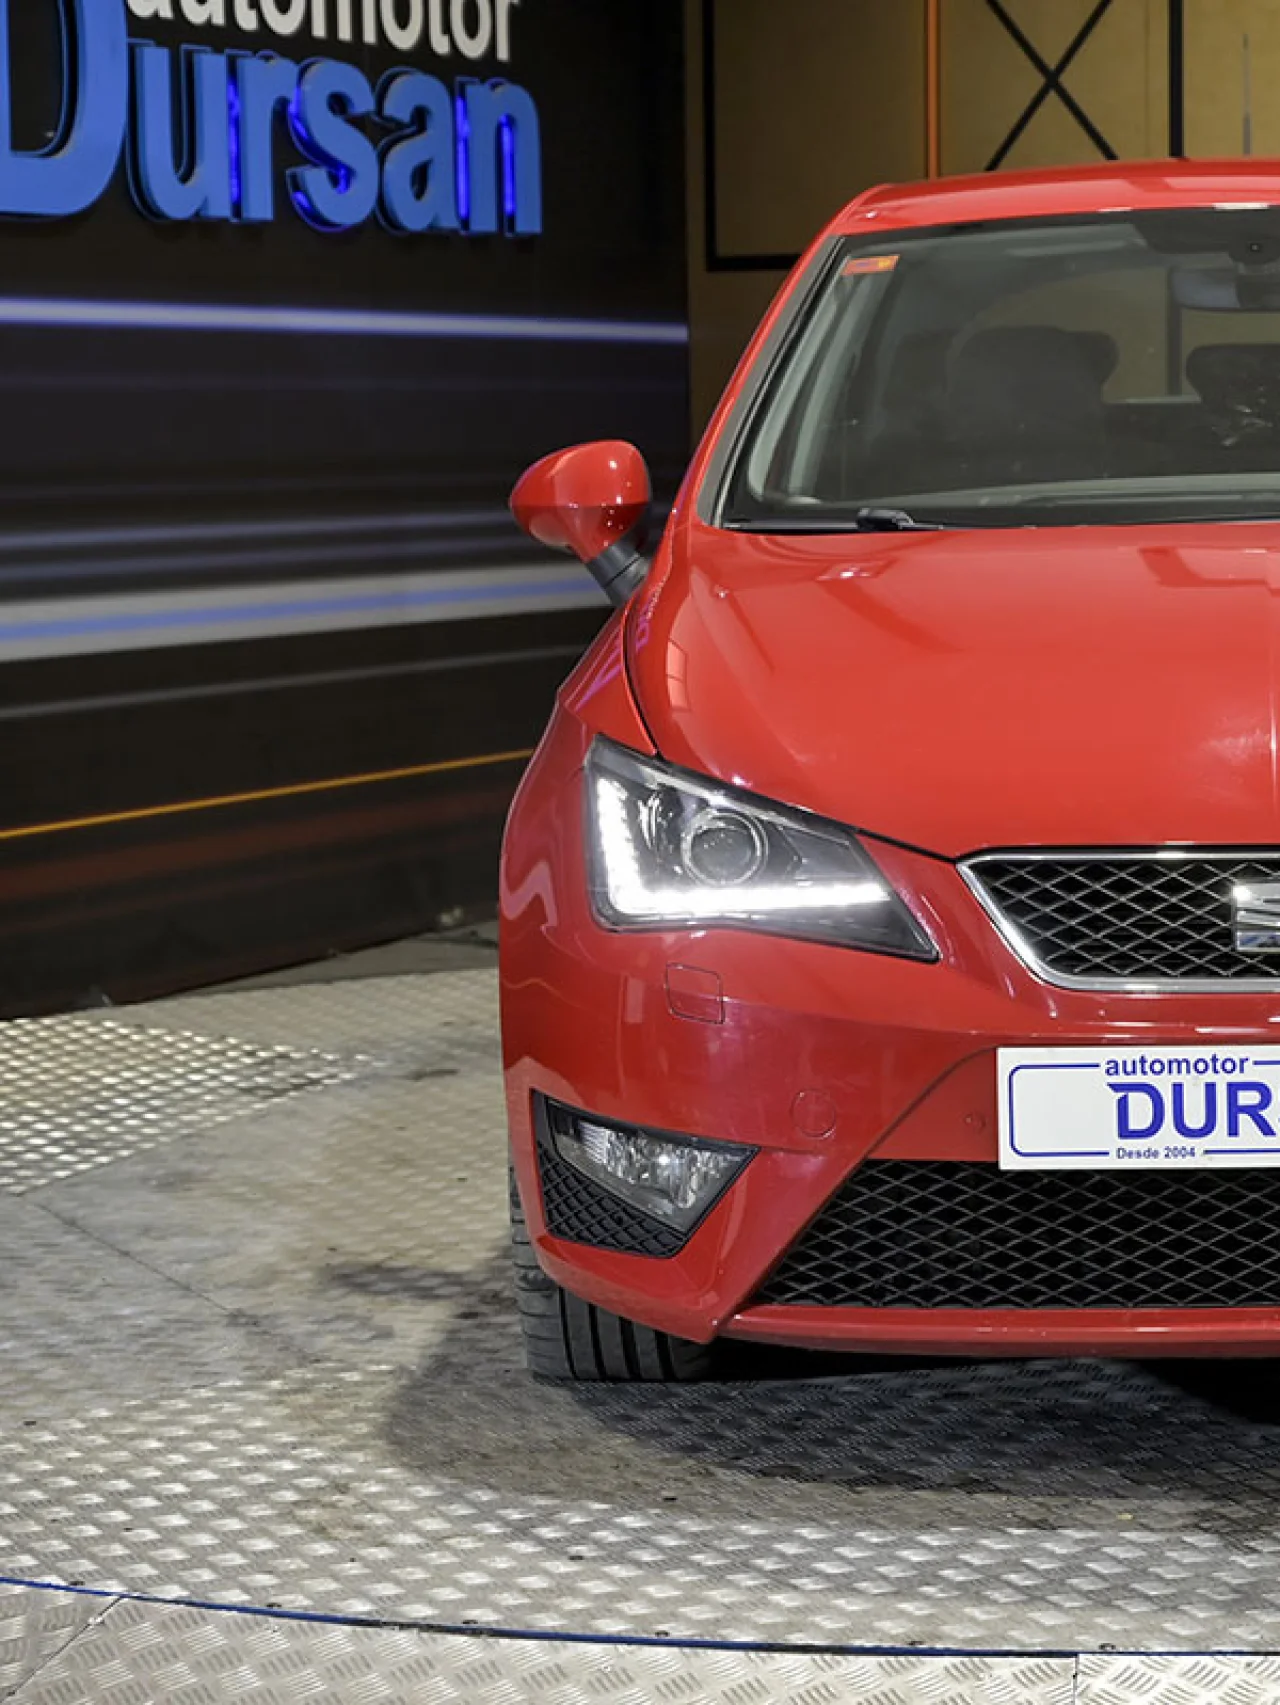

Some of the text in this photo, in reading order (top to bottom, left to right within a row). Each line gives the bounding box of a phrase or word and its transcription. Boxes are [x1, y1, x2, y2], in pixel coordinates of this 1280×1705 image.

[128, 0, 519, 62] omotor
[0, 0, 543, 237] Dursan
[1105, 1053, 1250, 1076] automotor
[1116, 1146, 1196, 1159] Desde 2004
